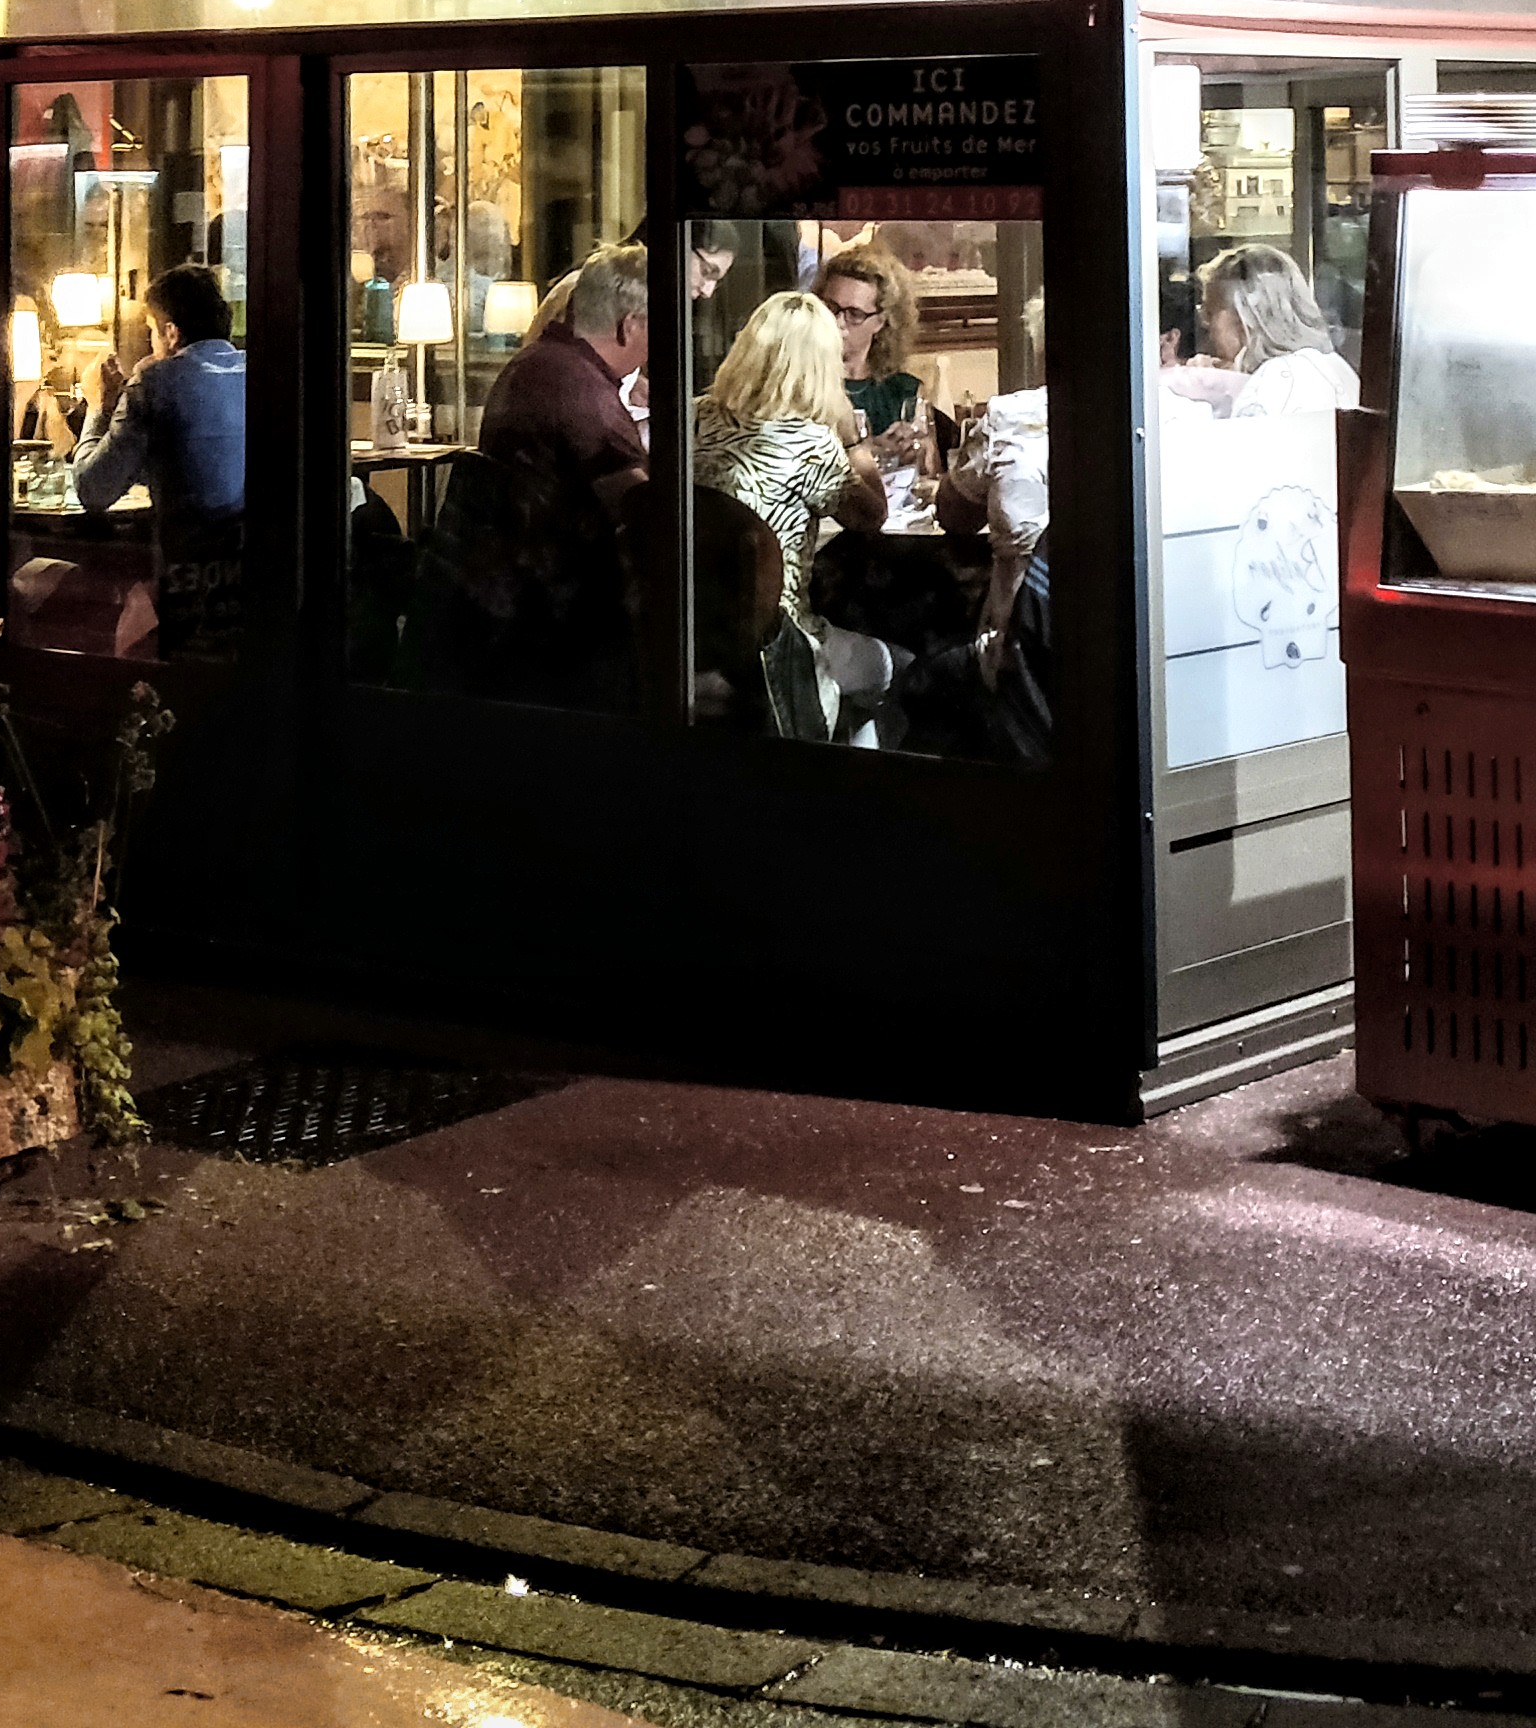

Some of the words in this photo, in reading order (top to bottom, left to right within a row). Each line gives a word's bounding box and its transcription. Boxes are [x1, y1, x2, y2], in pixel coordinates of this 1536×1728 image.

[912, 67, 966, 94] ICI
[845, 98, 1037, 128] COMMANDEZ
[845, 139, 882, 156] vos
[889, 133, 954, 156] Fruits
[962, 133, 989, 155] de
